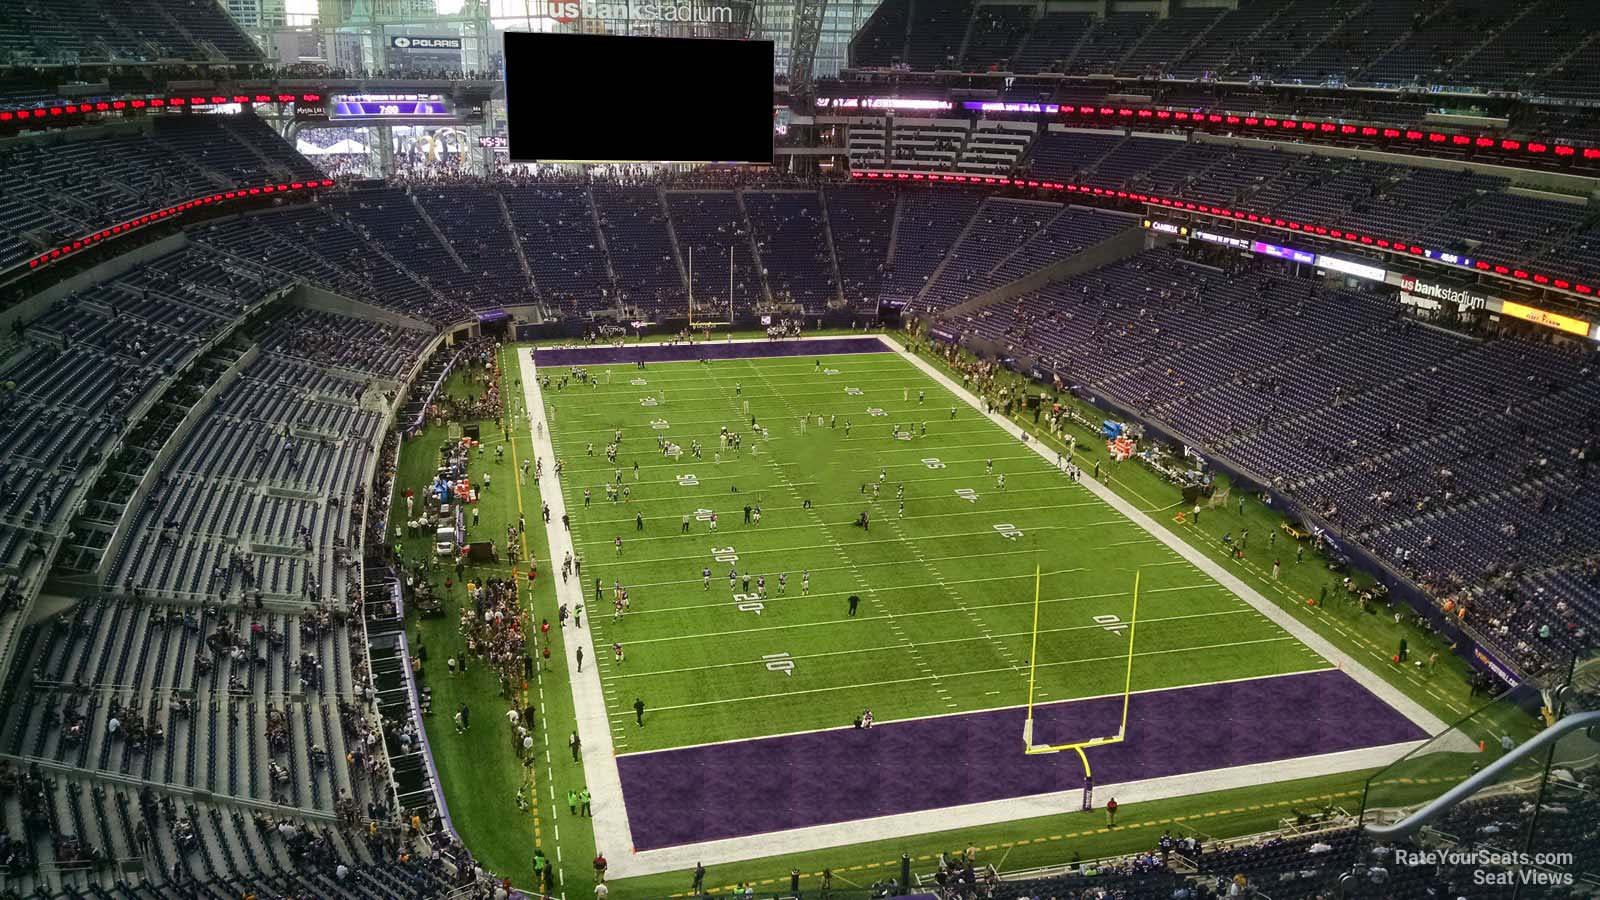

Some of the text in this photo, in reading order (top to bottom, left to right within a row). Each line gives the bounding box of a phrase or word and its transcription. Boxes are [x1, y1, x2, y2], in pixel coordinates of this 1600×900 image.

[412, 39, 459, 47] POLARIS
[711, 546, 739, 563] 30
[733, 592, 764, 612] 20
[1092, 614, 1128, 631] 10
[761, 652, 795, 671] 10
